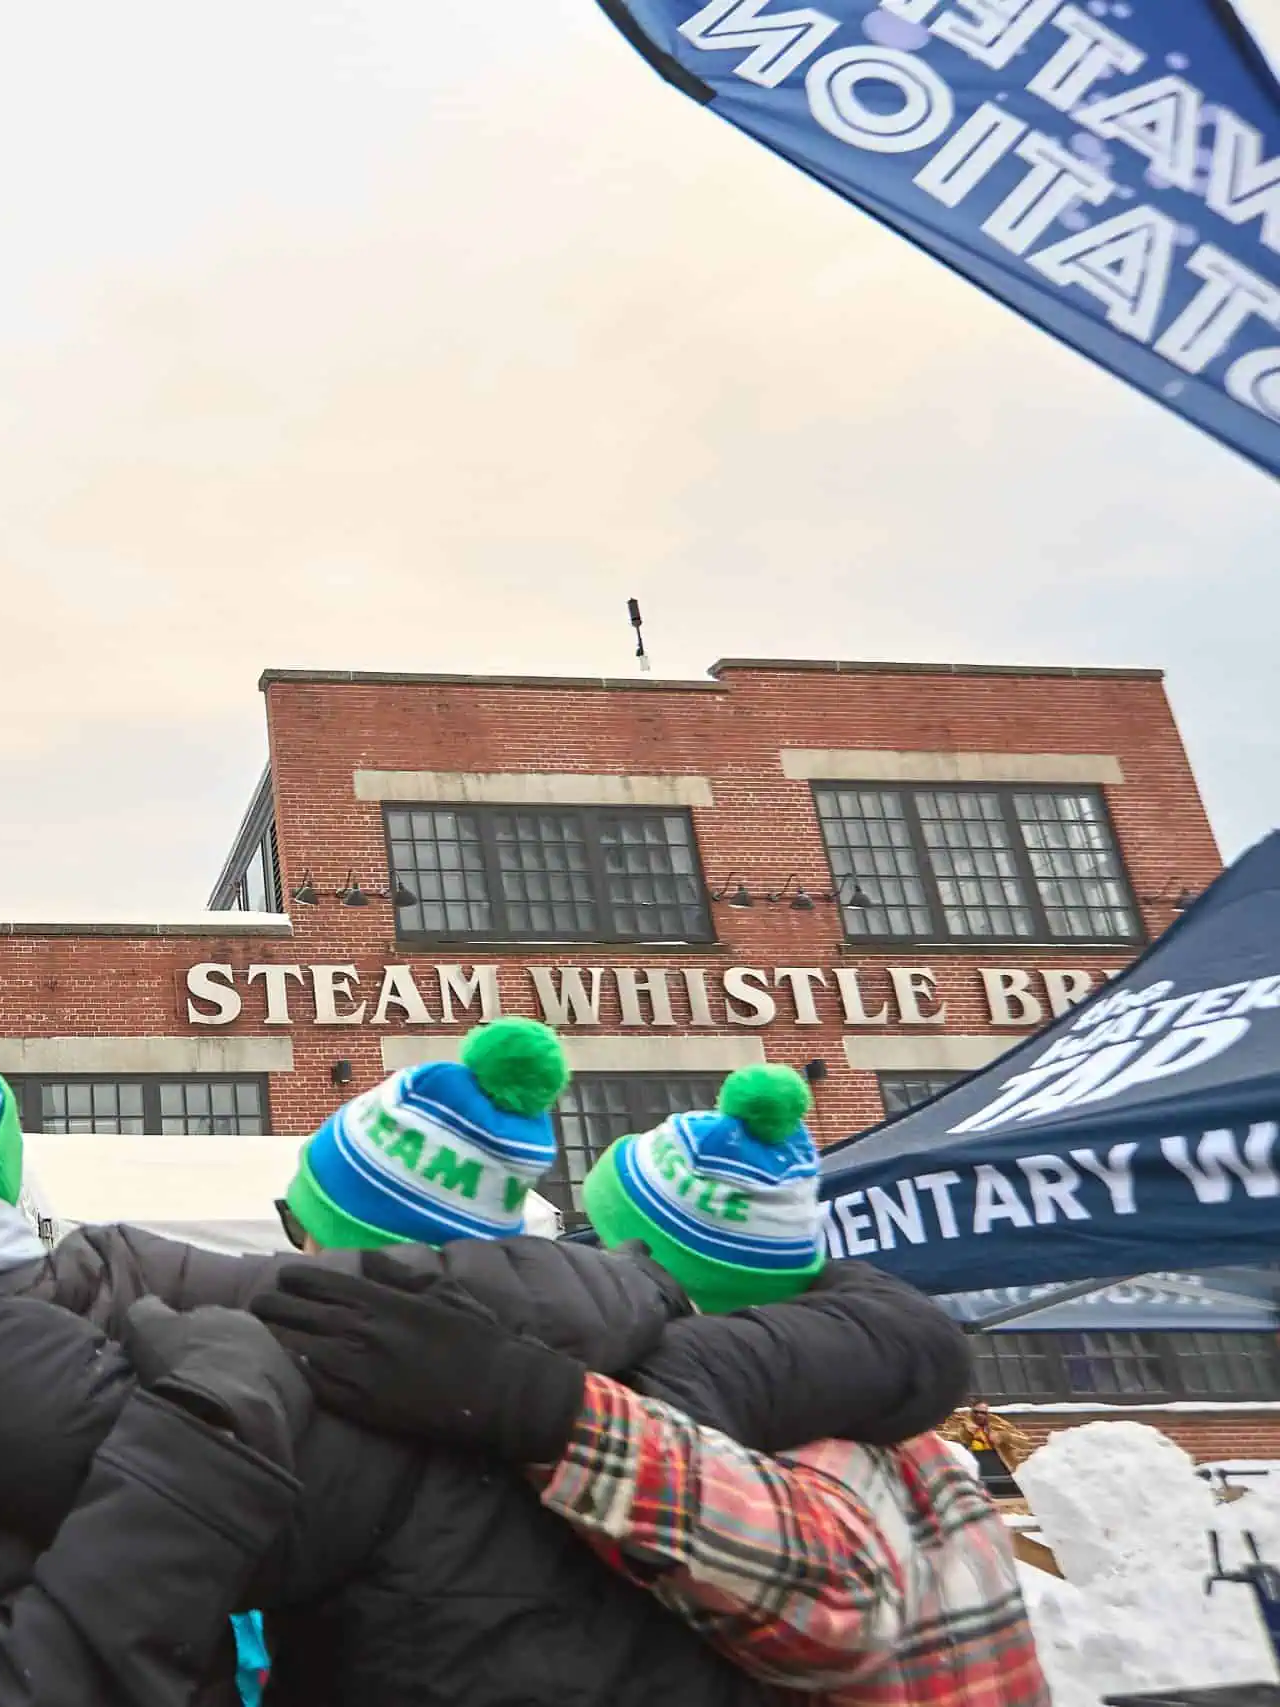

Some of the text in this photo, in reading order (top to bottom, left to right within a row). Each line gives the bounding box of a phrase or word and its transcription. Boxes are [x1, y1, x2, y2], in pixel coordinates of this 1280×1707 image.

[187, 963, 502, 1026] STEAM
[526, 966, 946, 1026] WHISTLE
[977, 967, 1123, 1026] BR
